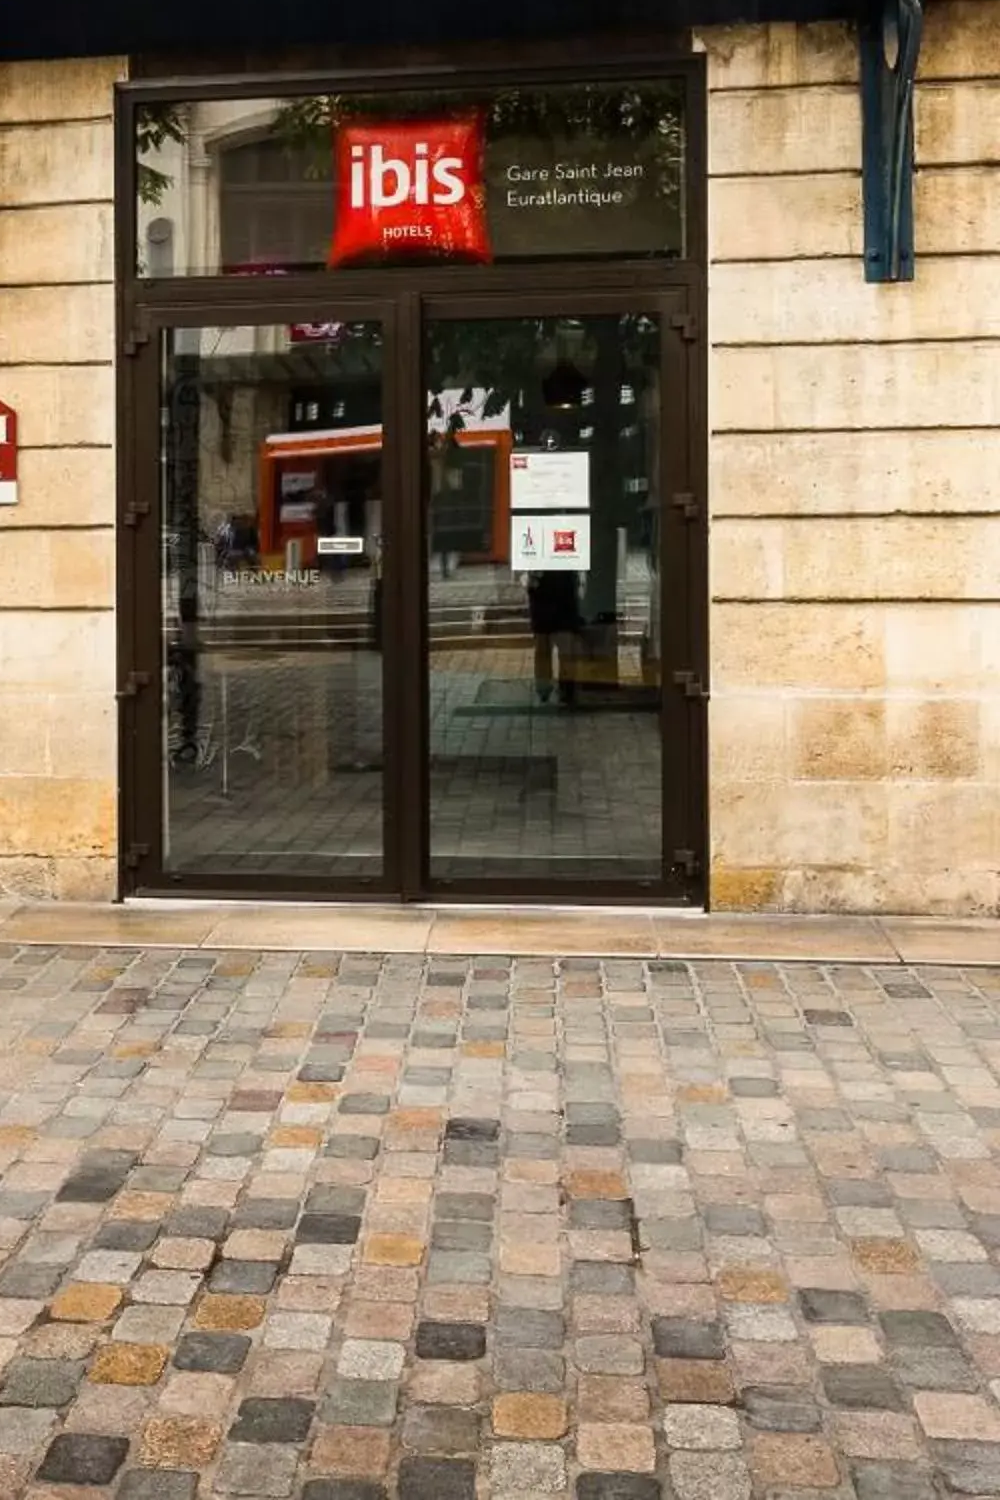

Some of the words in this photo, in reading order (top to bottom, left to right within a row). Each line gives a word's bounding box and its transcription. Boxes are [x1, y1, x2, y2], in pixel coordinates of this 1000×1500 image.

[351, 142, 465, 208] ibis
[507, 165, 549, 181] Gare
[555, 163, 598, 180] Saint
[603, 163, 643, 178] Jean
[507, 188, 623, 207] Euratlantique
[383, 225, 433, 239] HOTELS
[223, 569, 321, 585] BIENVENUE
